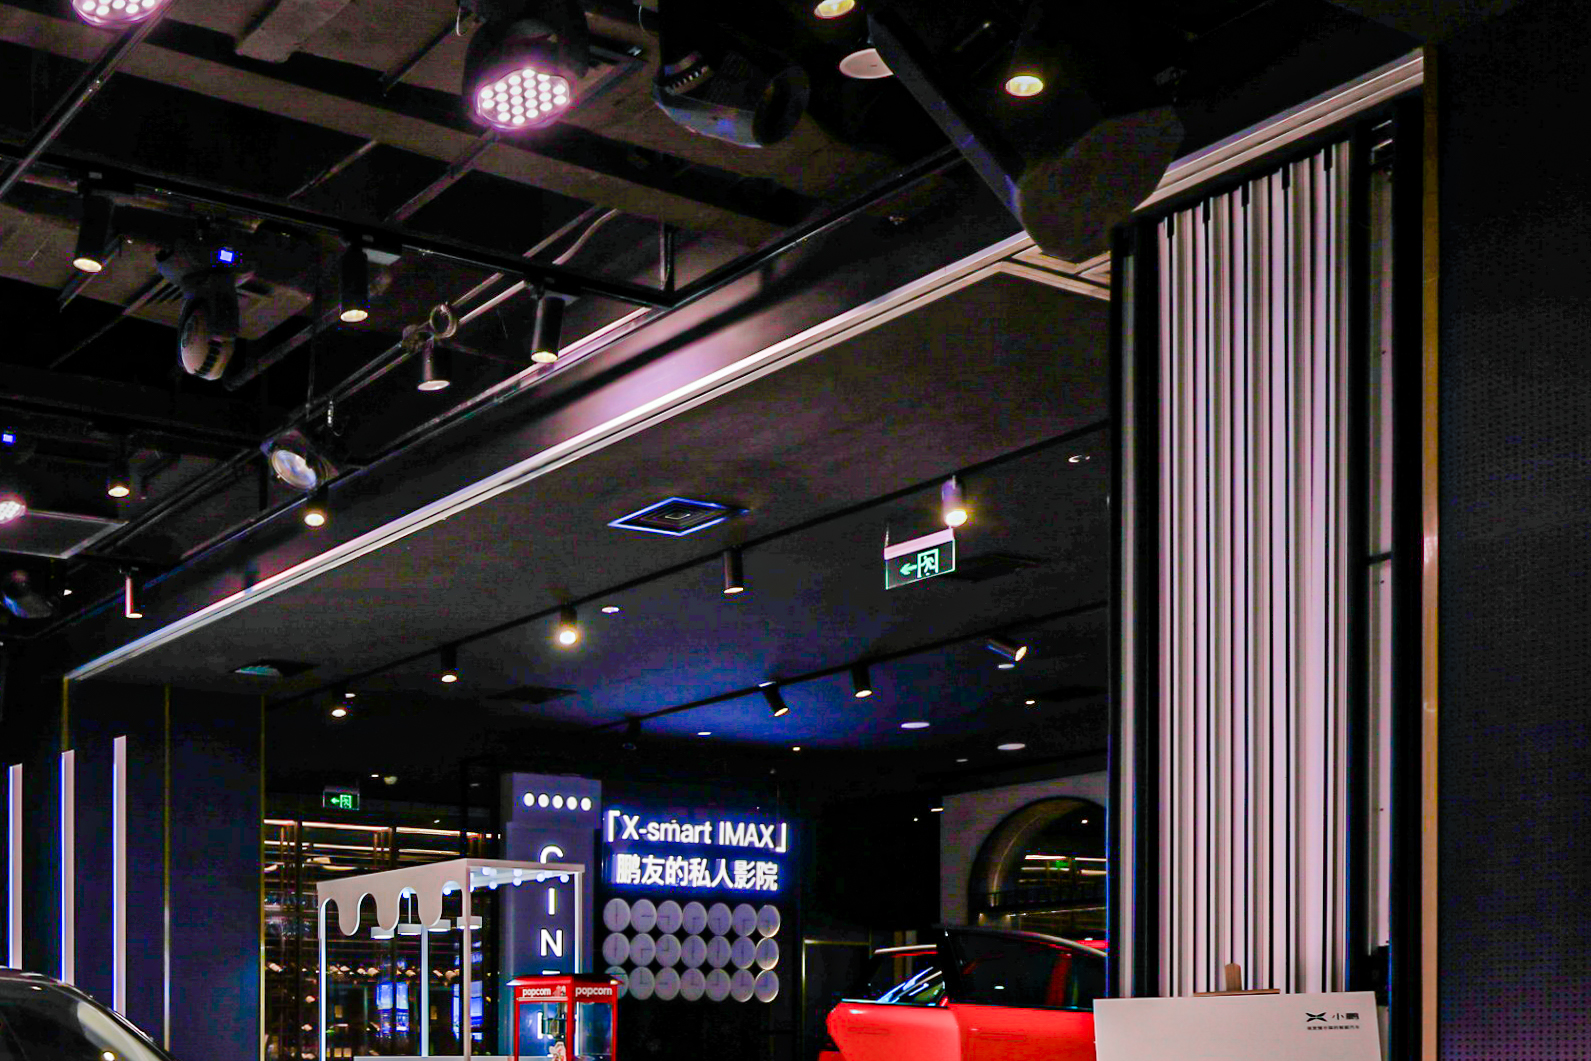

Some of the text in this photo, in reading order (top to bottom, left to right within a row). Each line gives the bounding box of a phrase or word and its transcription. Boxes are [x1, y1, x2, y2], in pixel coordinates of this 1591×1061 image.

[615, 853, 779, 891] 鹏友的私人影院
[575, 986, 613, 997] popcorn
